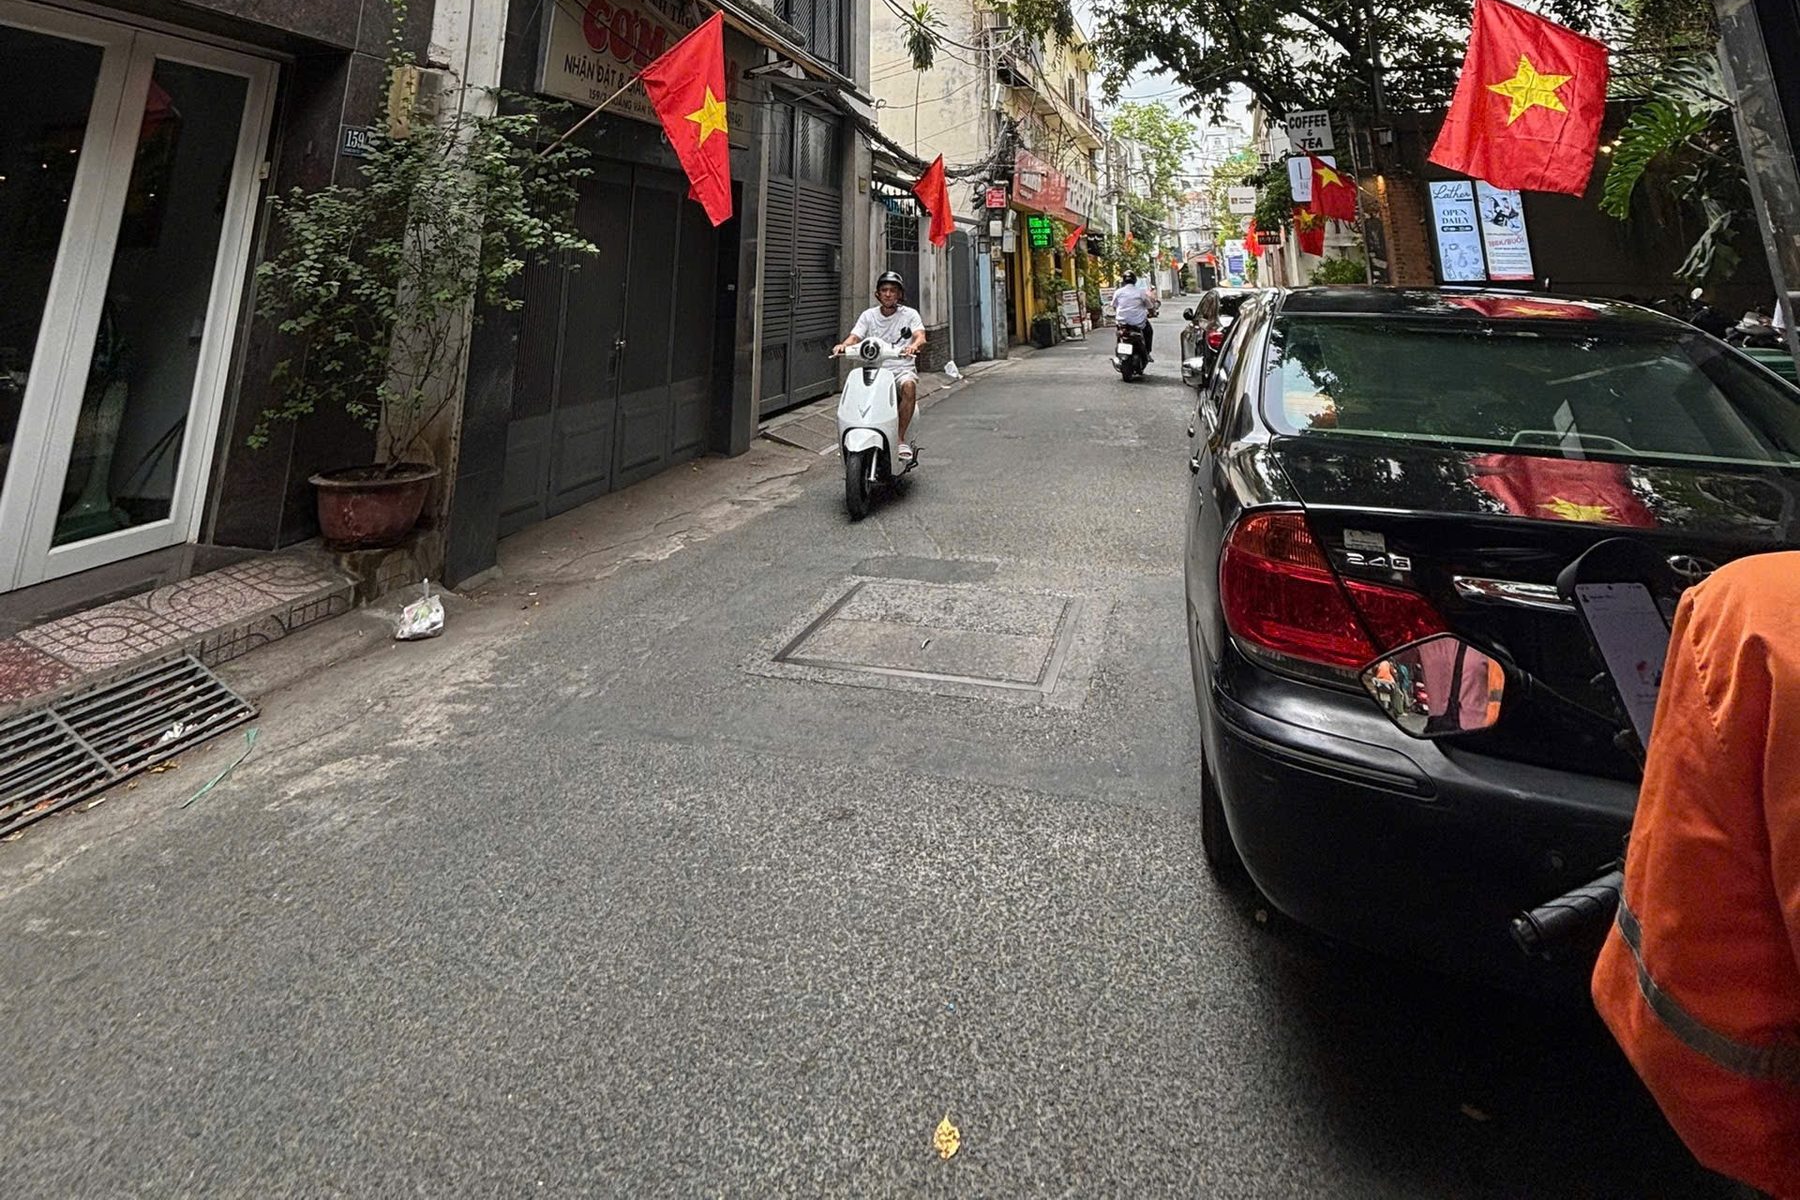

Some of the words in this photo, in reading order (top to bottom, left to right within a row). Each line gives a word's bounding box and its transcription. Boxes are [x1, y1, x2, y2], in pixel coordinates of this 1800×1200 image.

[1289, 113, 1327, 130] COFFEE
[1307, 129, 1314, 137] &
[1301, 137, 1323, 149] TEA
[1442, 208, 1468, 217] OPEN
[1442, 217, 1470, 225] DAILY
